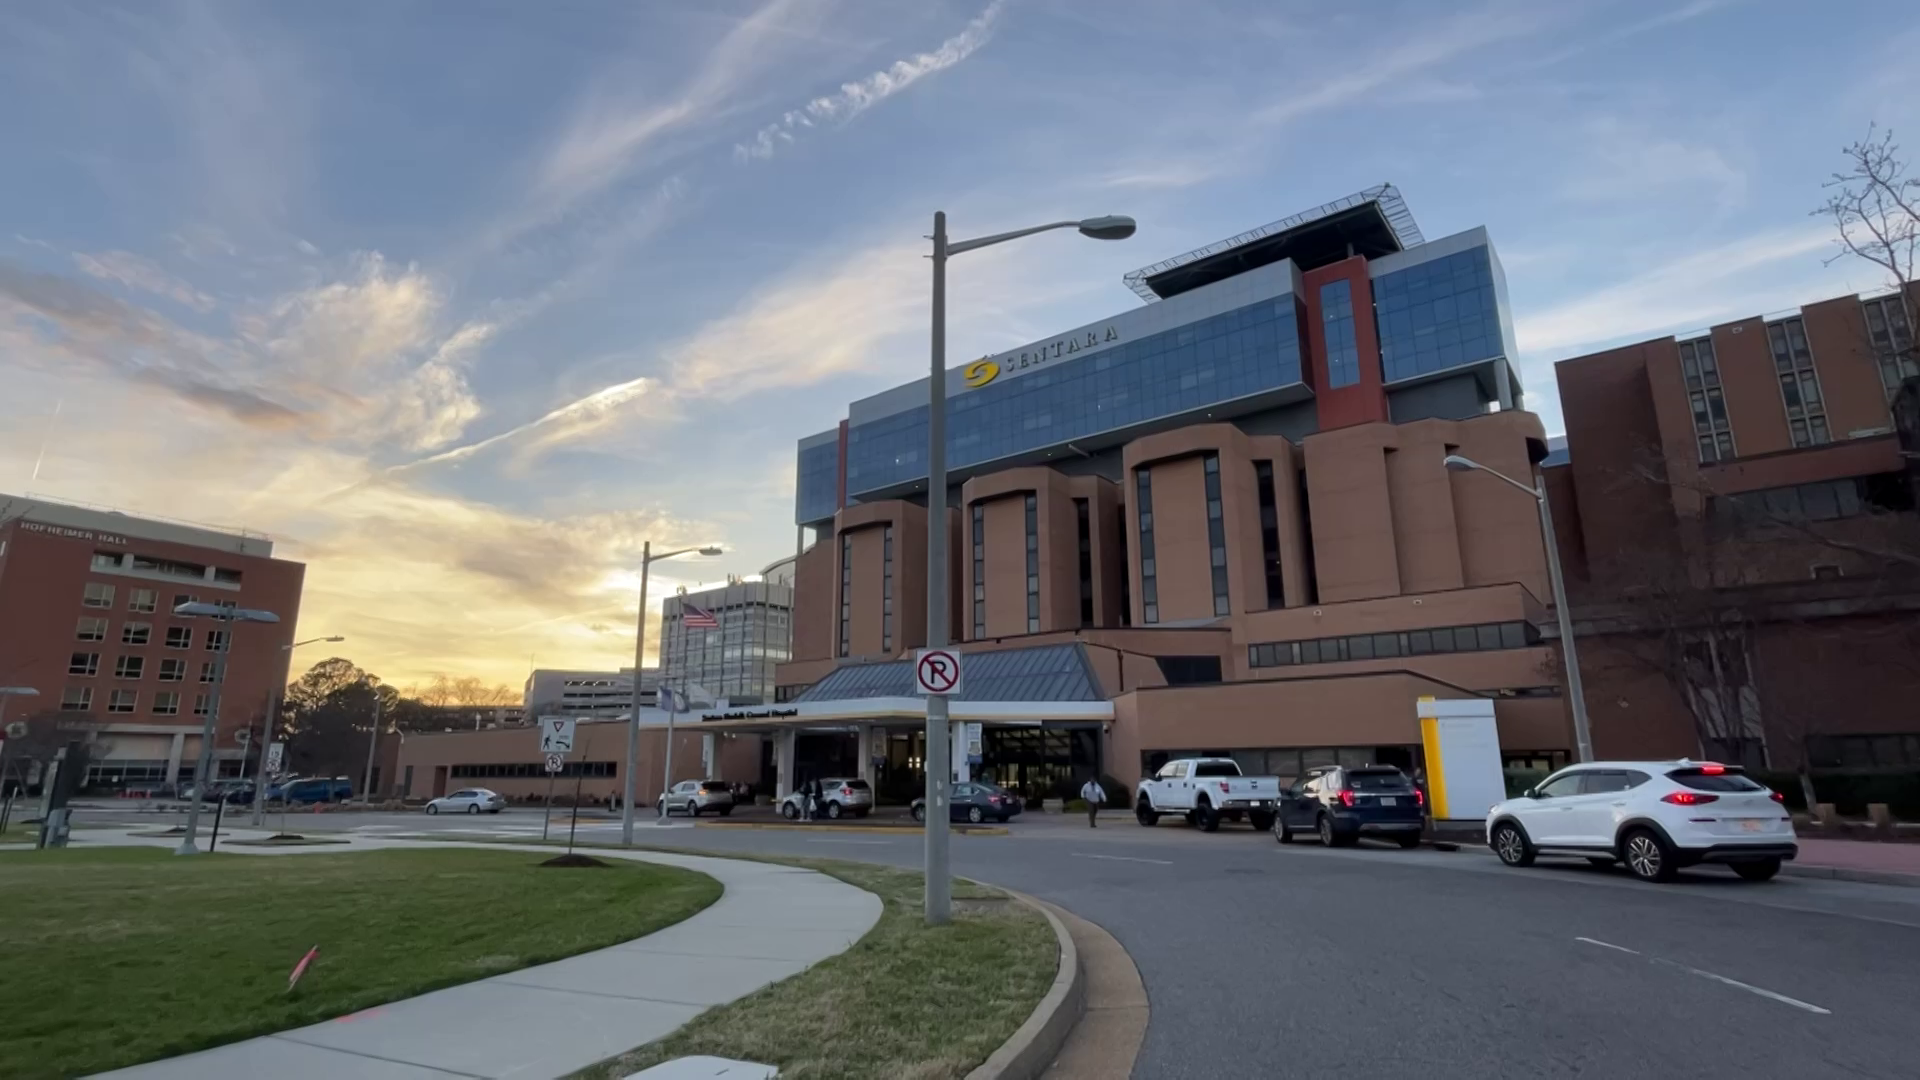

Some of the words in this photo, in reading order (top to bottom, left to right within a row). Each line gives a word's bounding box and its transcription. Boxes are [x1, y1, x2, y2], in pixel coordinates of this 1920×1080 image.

[1006, 326, 1118, 373] SENTARA
[20, 521, 93, 540] HOFHEIMER
[98, 533, 128, 545] HALL
